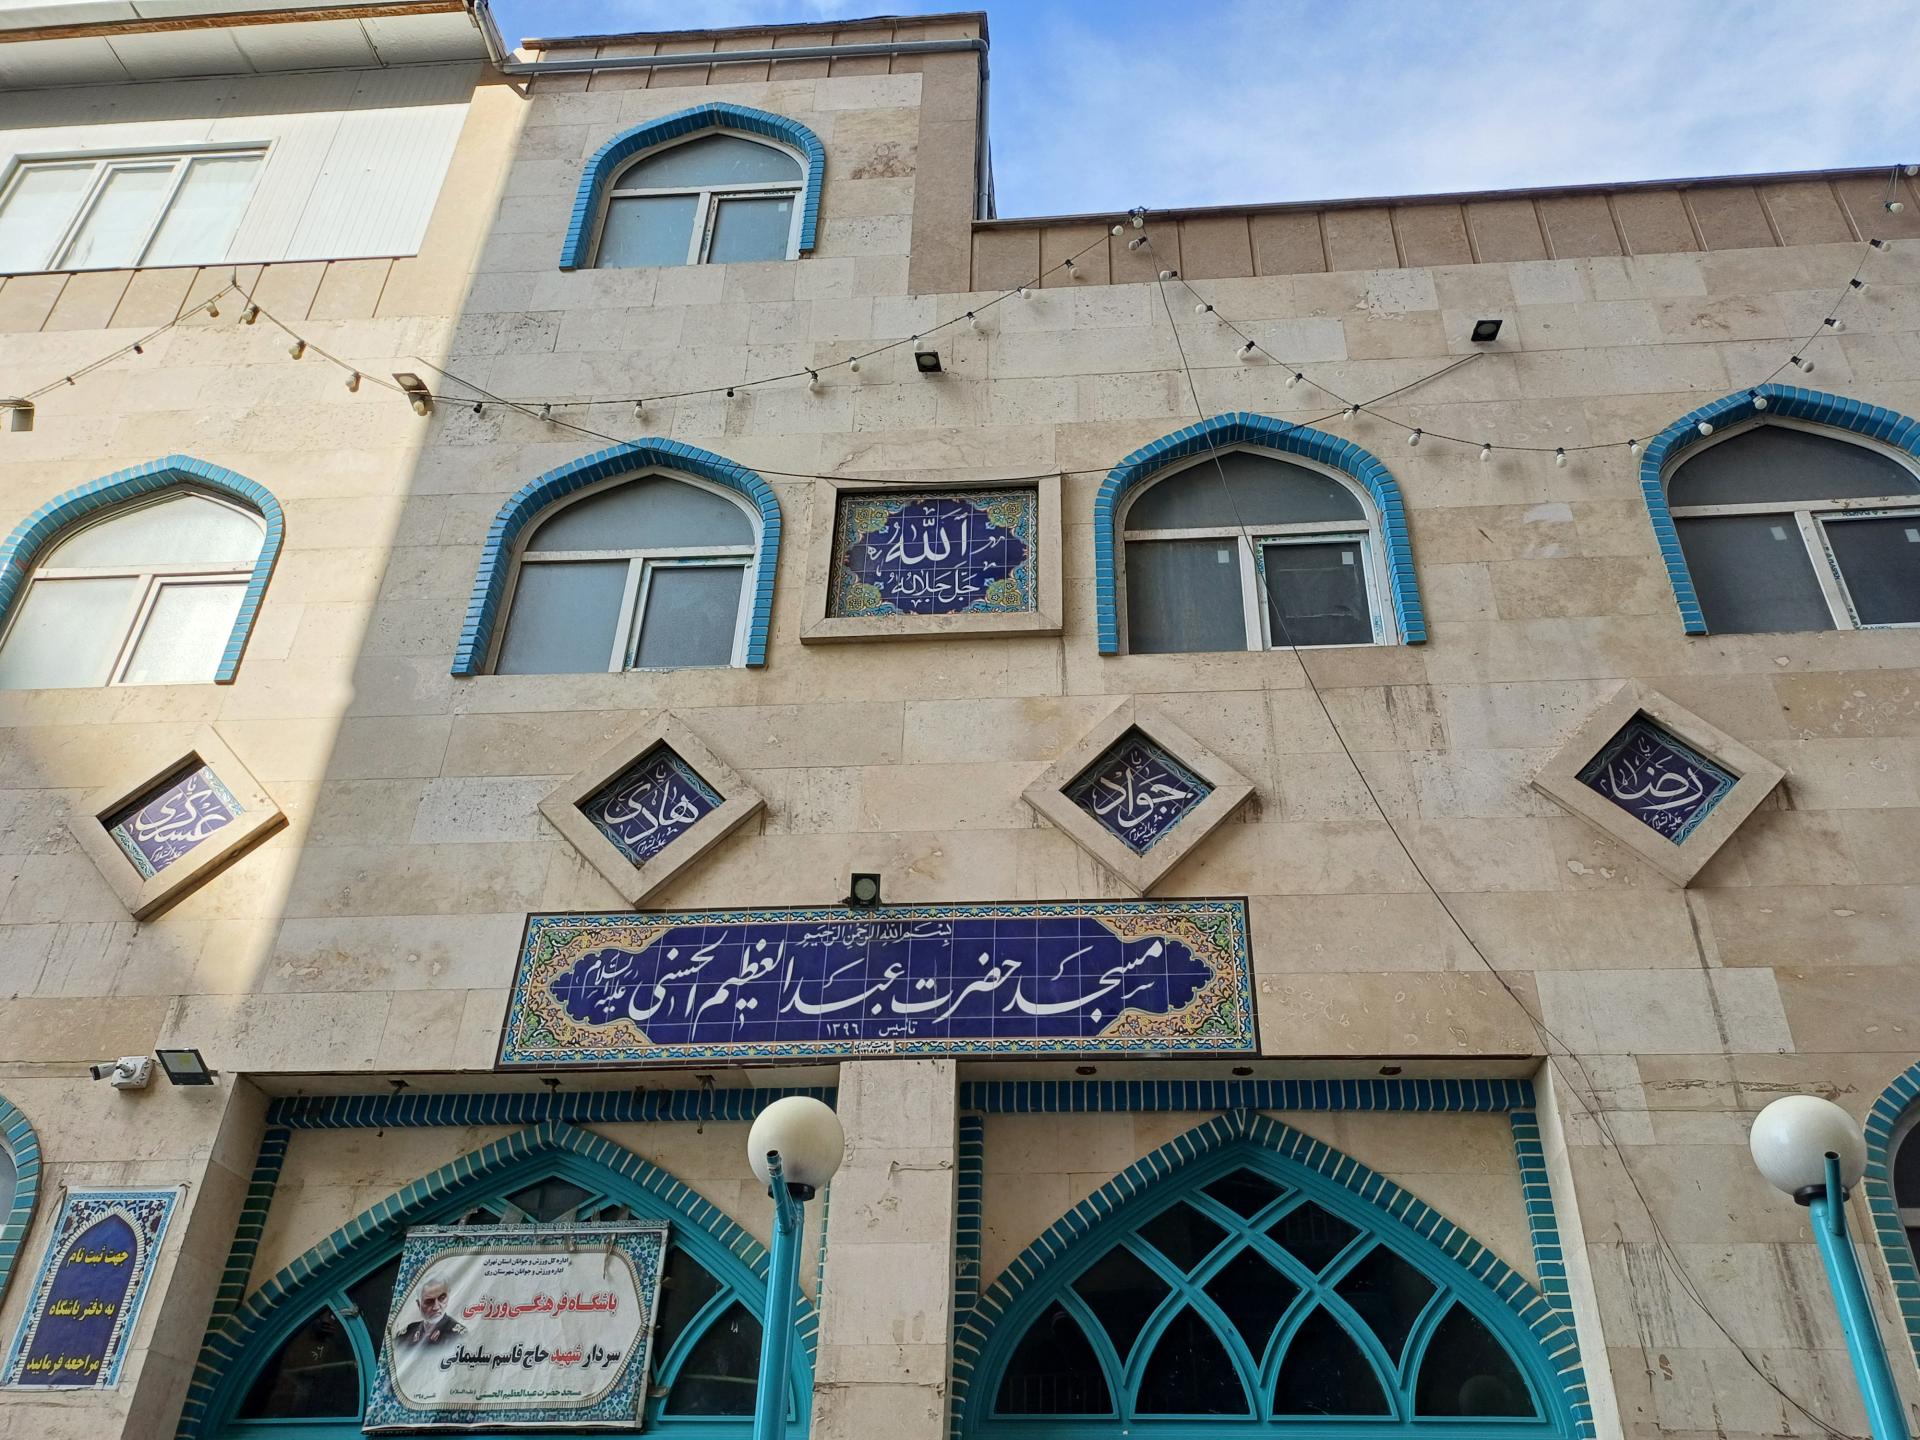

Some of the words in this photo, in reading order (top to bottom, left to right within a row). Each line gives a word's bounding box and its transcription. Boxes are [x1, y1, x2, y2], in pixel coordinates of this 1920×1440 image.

[1092, 767, 1194, 828] جواد
[1608, 762, 1703, 810] رضا
[603, 780, 699, 845] هادی
[891, 951, 1024, 1023] حضرت
[1002, 940, 1163, 1023] مسجد
[826, 1022, 859, 1037] ۱۳۹۶
[67, 1248, 85, 1268] نام
[84, 1245, 105, 1267] ثبت
[105, 1250, 128, 1267] جهت
[49, 1299, 80, 1320] باشگاه
[79, 1298, 104, 1321] دفتر
[105, 1304, 115, 1320] به
[462, 1294, 509, 1319] ورزشی
[508, 1291, 568, 1318] فرهنگی
[569, 1292, 619, 1316] باشگاه
[27, 1352, 65, 1376] فرمایید
[64, 1357, 100, 1376] مراجعه
[440, 1344, 492, 1371] سلیمانی
[492, 1343, 523, 1370] قاسم
[522, 1344, 550, 1369] حاج
[550, 1344, 582, 1367] شهید
[581, 1344, 621, 1369] سردار
